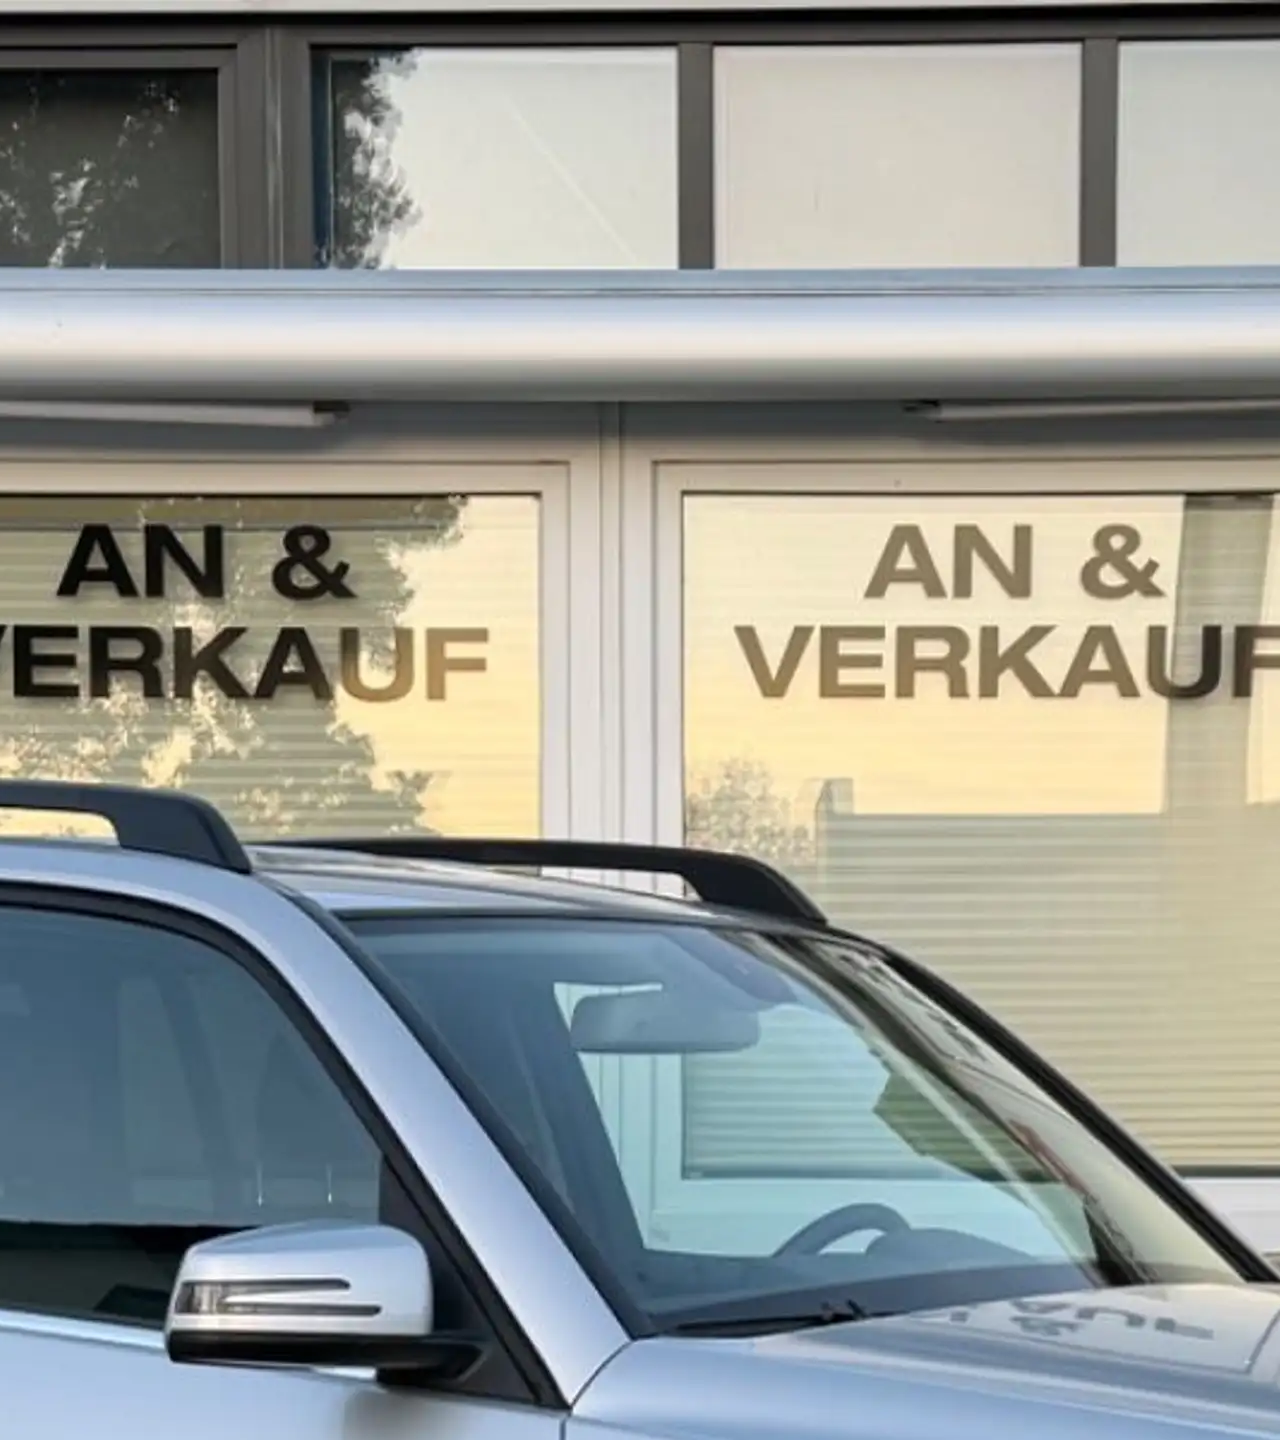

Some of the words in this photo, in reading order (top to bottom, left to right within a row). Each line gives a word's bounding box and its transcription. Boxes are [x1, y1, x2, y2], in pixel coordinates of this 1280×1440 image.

[55, 523, 224, 598] AN
[271, 523, 358, 600] &
[862, 522, 1033, 599] AN
[1078, 522, 1167, 600] &
